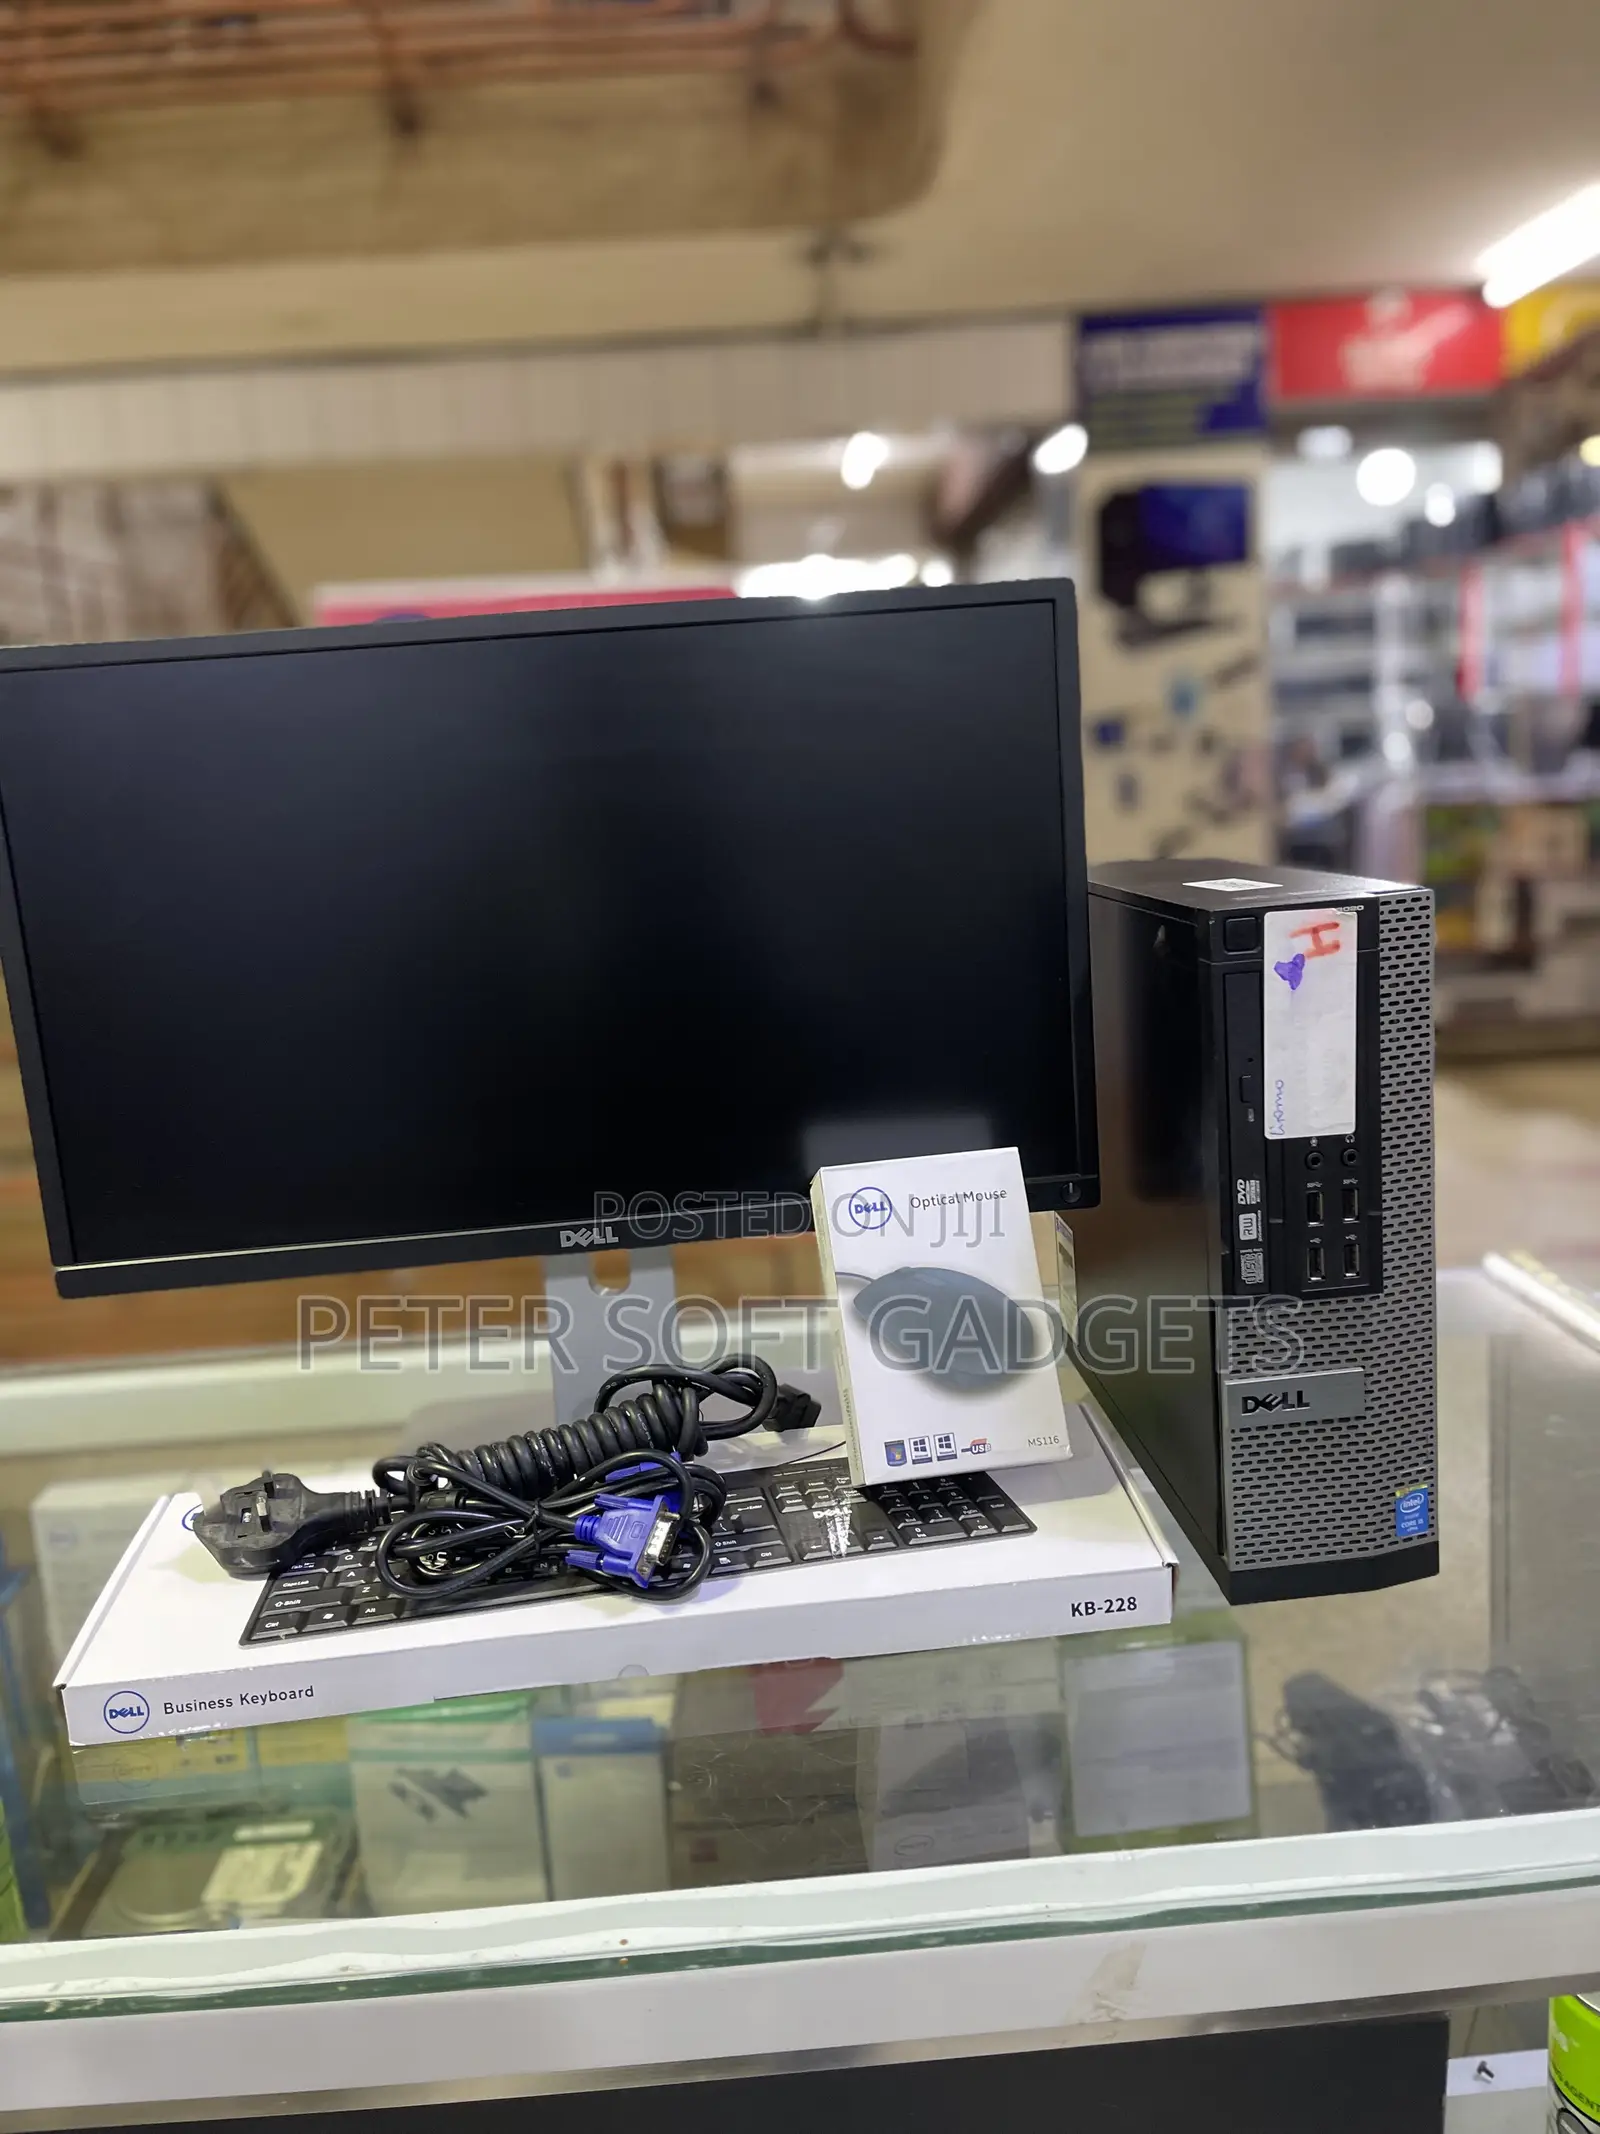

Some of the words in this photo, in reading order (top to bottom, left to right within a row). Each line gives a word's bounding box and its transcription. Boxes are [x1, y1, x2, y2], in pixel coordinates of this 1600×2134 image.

[854, 1201, 888, 1215] DELL
[910, 1193, 961, 1211] Optical
[963, 1187, 1008, 1203] Mouse
[559, 1225, 619, 1249] DELL
[1241, 1390, 1311, 1416] DELL
[1027, 1435, 1060, 1447] MS116
[1070, 1596, 1139, 1619] KB-228
[163, 1694, 233, 1715] Business
[239, 1685, 315, 1709] Keyboard
[109, 1707, 145, 1719] DELL
